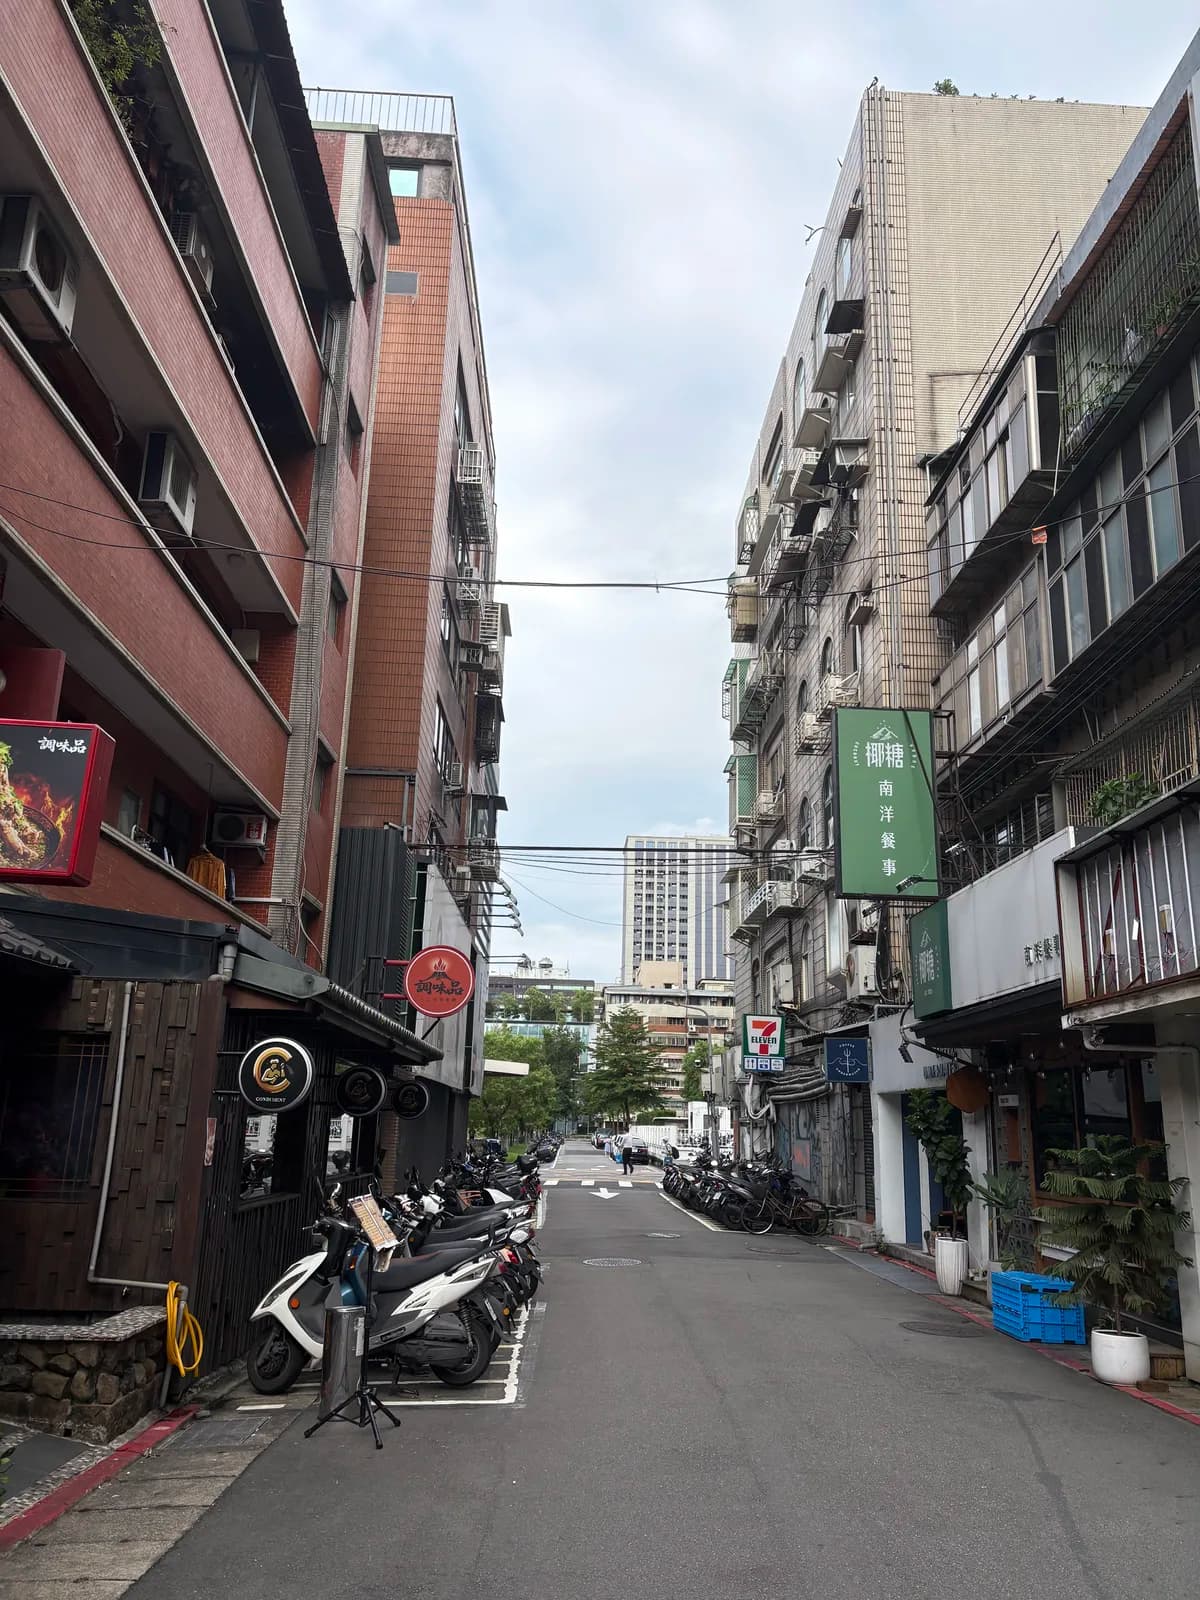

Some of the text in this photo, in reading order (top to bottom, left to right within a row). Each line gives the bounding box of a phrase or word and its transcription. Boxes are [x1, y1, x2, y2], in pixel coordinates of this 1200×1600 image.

[37, 737, 87, 754] 調味品
[865, 741, 904, 768] 椰糖
[878, 779, 897, 876] 南洋餐事
[414, 980, 464, 996] 調味品
[752, 1020, 777, 1054] 7
